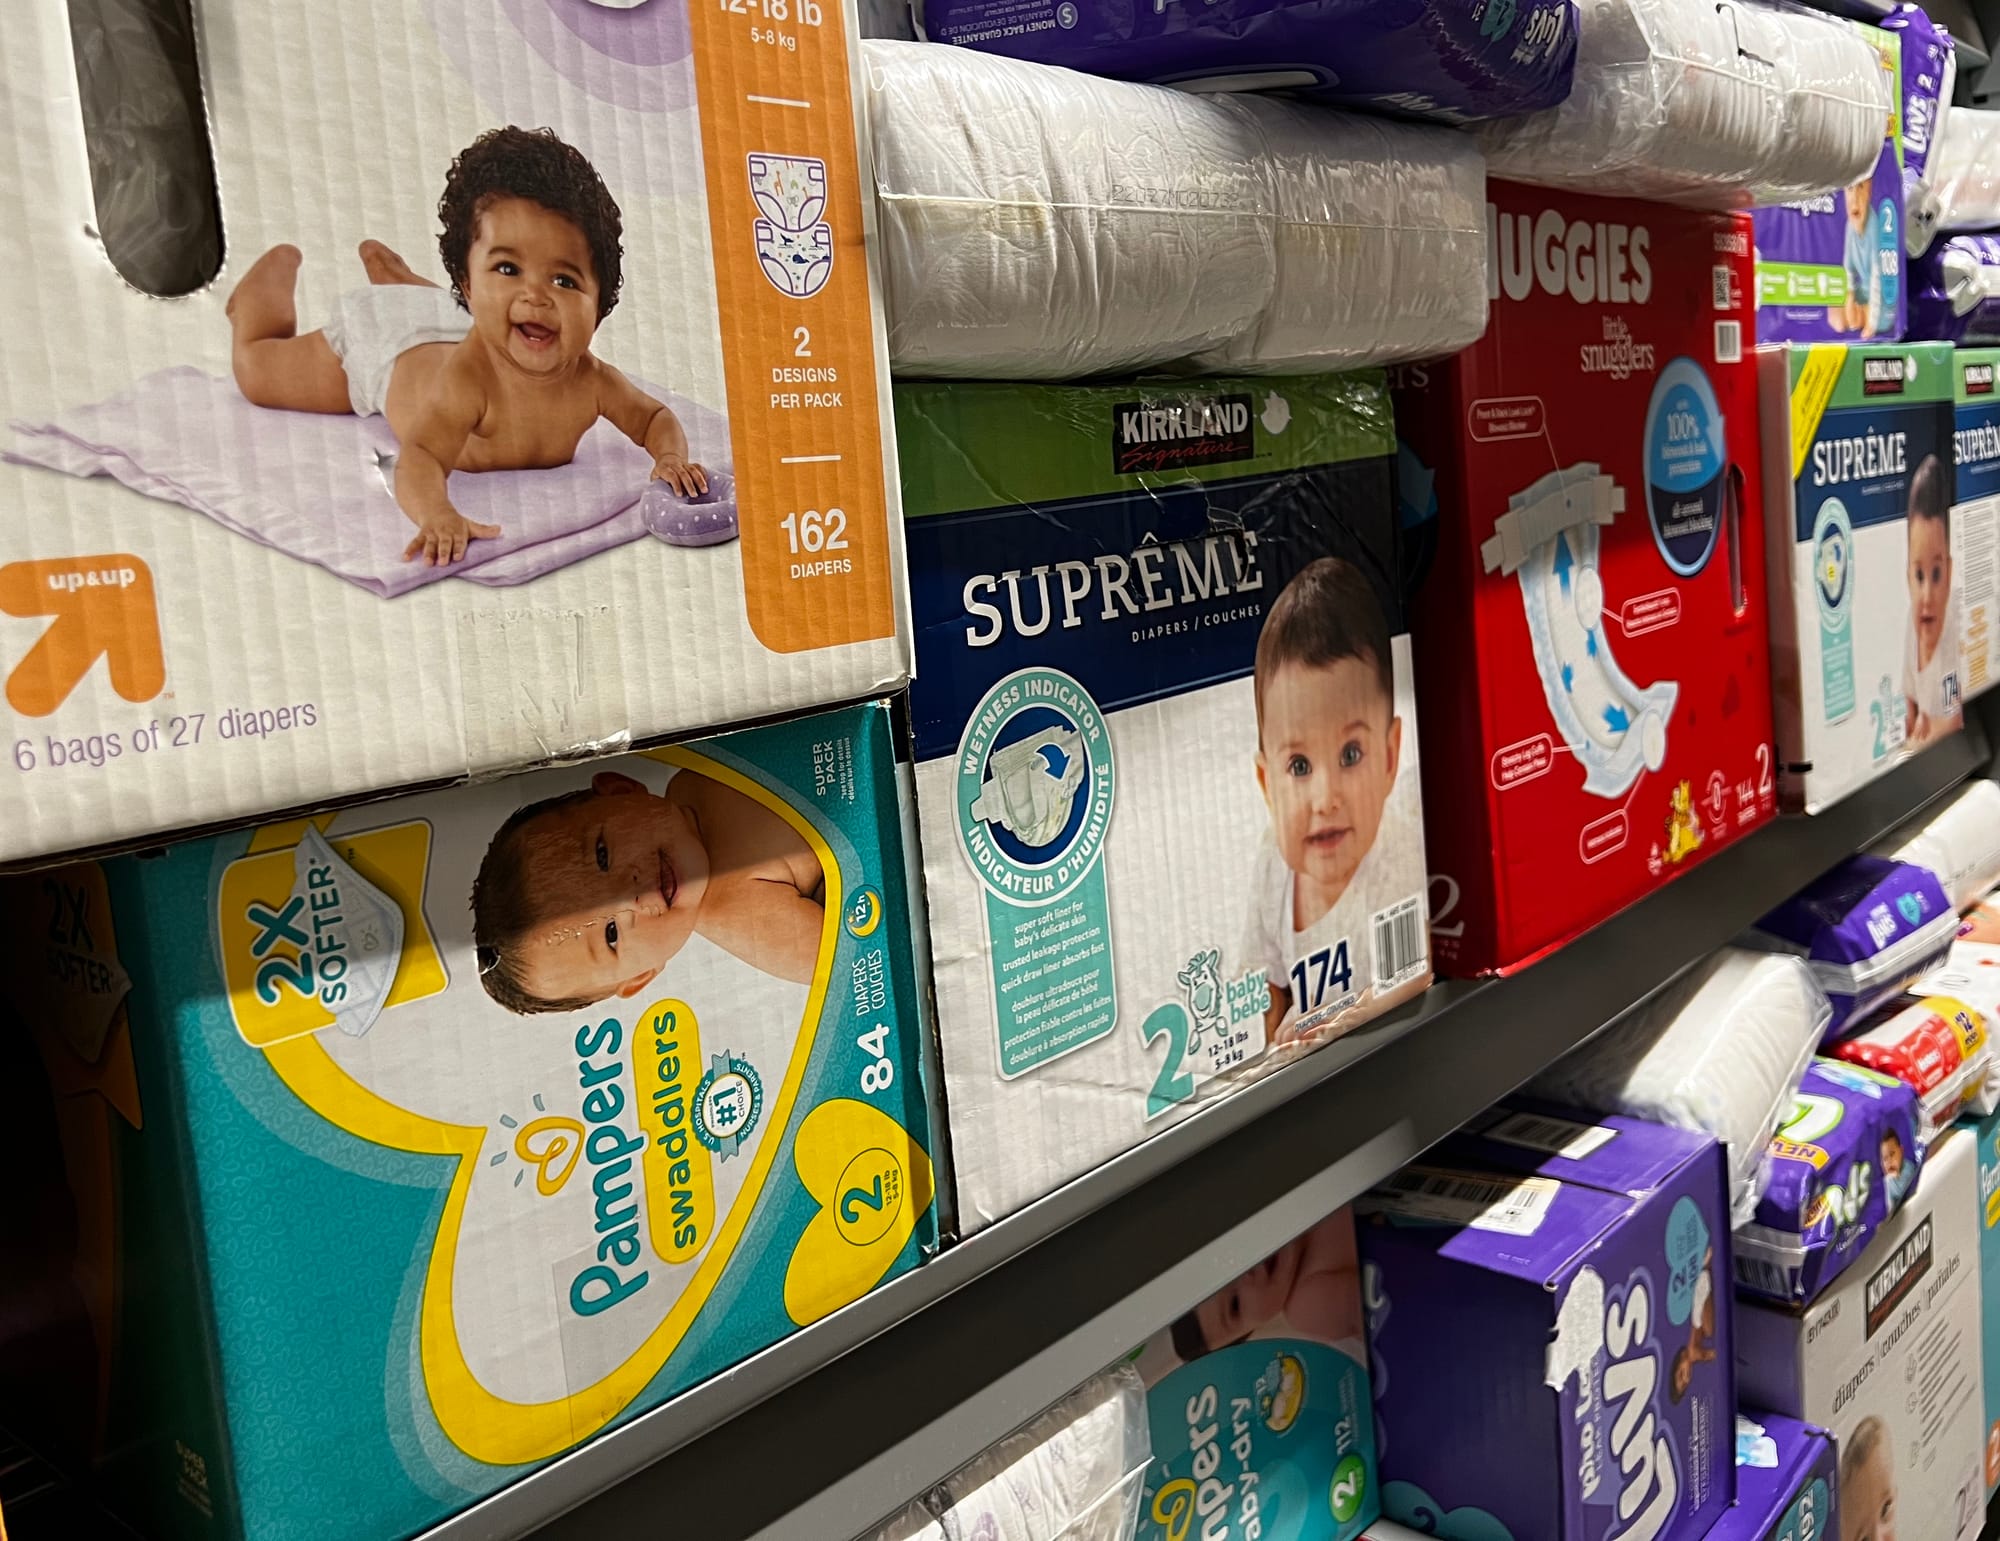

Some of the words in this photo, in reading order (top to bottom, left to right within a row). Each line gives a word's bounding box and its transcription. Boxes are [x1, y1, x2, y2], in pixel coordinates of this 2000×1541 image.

[795, 0, 824, 27] lb
[1002, 24, 1025, 37] BACK
[1024, 19, 1056, 33] MONEY
[750, 26, 775, 46] 5-8
[778, 32, 797, 52] kg
[951, 28, 1002, 45] GUARANTEE
[1900, 94, 1927, 154] Luvs
[1917, 74, 1933, 93] 2
[1883, 206, 1894, 233] 2
[793, 326, 812, 357] 2
[1602, 315, 1630, 343] little
[772, 367, 838, 384] DESIGNS
[1580, 333, 1655, 380] snugglers
[770, 393, 801, 409] PER
[804, 392, 843, 408] PACK
[1121, 402, 1249, 445] KIRKLAND
[1120, 438, 1250, 471] Signature
[1812, 425, 1907, 487] SUPRÊME
[780, 507, 849, 554] 162
[48, 566, 137, 592] up&up
[790, 558, 852, 580] DIAPERS
[964, 530, 1264, 648] SUPRÊME
[1131, 615, 1189, 643] DIAPERS
[1203, 604, 1262, 628] COUCHES
[15, 739, 36, 771] 6
[47, 732, 123, 768] bags
[132, 719, 160, 753] of
[167, 712, 207, 748] 27
[217, 702, 318, 740] diapers
[963, 684, 1020, 776] WETNESS
[1024, 678, 1101, 744] INDICATOR
[1869, 700, 1887, 760] 2
[812, 741, 827, 796] SUPER
[823, 740, 836, 784] PACK
[1756, 742, 1773, 796] 2
[968, 825, 1055, 895] INDICATEUR
[1057, 762, 1110, 886] D'HUMIDITÉ
[44, 876, 94, 951] 2X
[854, 894, 867, 923] 12h
[1014, 919, 1037, 935] super
[1037, 912, 1054, 926] soft
[1054, 906, 1072, 919] liner
[1071, 901, 1084, 914] for
[1427, 874, 1466, 938] 2
[246, 895, 316, 1004] 2X
[1002, 951, 1031, 972] trusted
[1031, 942, 1062, 960] leakage
[1062, 926, 1101, 949] protection
[1014, 932, 1040, 949] baby's
[1040, 922, 1070, 939] delicate
[1070, 914, 1087, 928] skin
[852, 957, 870, 1016] DIAPERS
[868, 948, 885, 1010] COUCHES
[1000, 974, 1023, 994] quick
[1023, 966, 1042, 982] draw
[1043, 959, 1061, 974] liner
[1061, 949, 1090, 967] absorbs
[1090, 942, 1105, 955] fast
[1225, 969, 1267, 1004] baby
[1290, 938, 1353, 1015] 174
[1011, 991, 1044, 1013] doublure
[1083, 969, 1100, 985] pour
[1023, 1007, 1042, 1025] peau
[1070, 989, 1080, 1001] de
[1230, 991, 1272, 1026] bébé
[1003, 1025, 1041, 1051] protection
[1082, 1003, 1093, 1016] les
[1009, 1043, 1043, 1066] doublure
[1049, 1021, 1088, 1047] absorption
[1087, 1012, 1109, 1031] rapide
[1234, 1029, 1249, 1047] lbs
[856, 1022, 894, 1095] 84
[1141, 1001, 1195, 1118] 2
[1215, 1054, 1231, 1070] 5-8
[1231, 1049, 1244, 1065] kg
[694, 1079, 711, 1133] HOSPITALS
[712, 1086, 738, 1127] #1
[735, 1080, 746, 1118] CHOICE
[739, 1102, 761, 1138] NURSES
[652, 1010, 697, 1249] swaddlers
[569, 1017, 650, 1317] Pampers
[891, 1169, 899, 1184] kg
[840, 1174, 884, 1224] 2
[885, 1182, 894, 1207] 12-18
[1672, 1271, 1685, 1294] 2
[1868, 1219, 1932, 1310] KIRKLAND
[1832, 1354, 1876, 1415] diapers
[1881, 1301, 1922, 1358] couches
[1603, 1283, 1679, 1541] Luvs
[1333, 1415, 1352, 1457] 112
[1576, 1421, 1602, 1500] pro
[1332, 1471, 1357, 1509] 2
